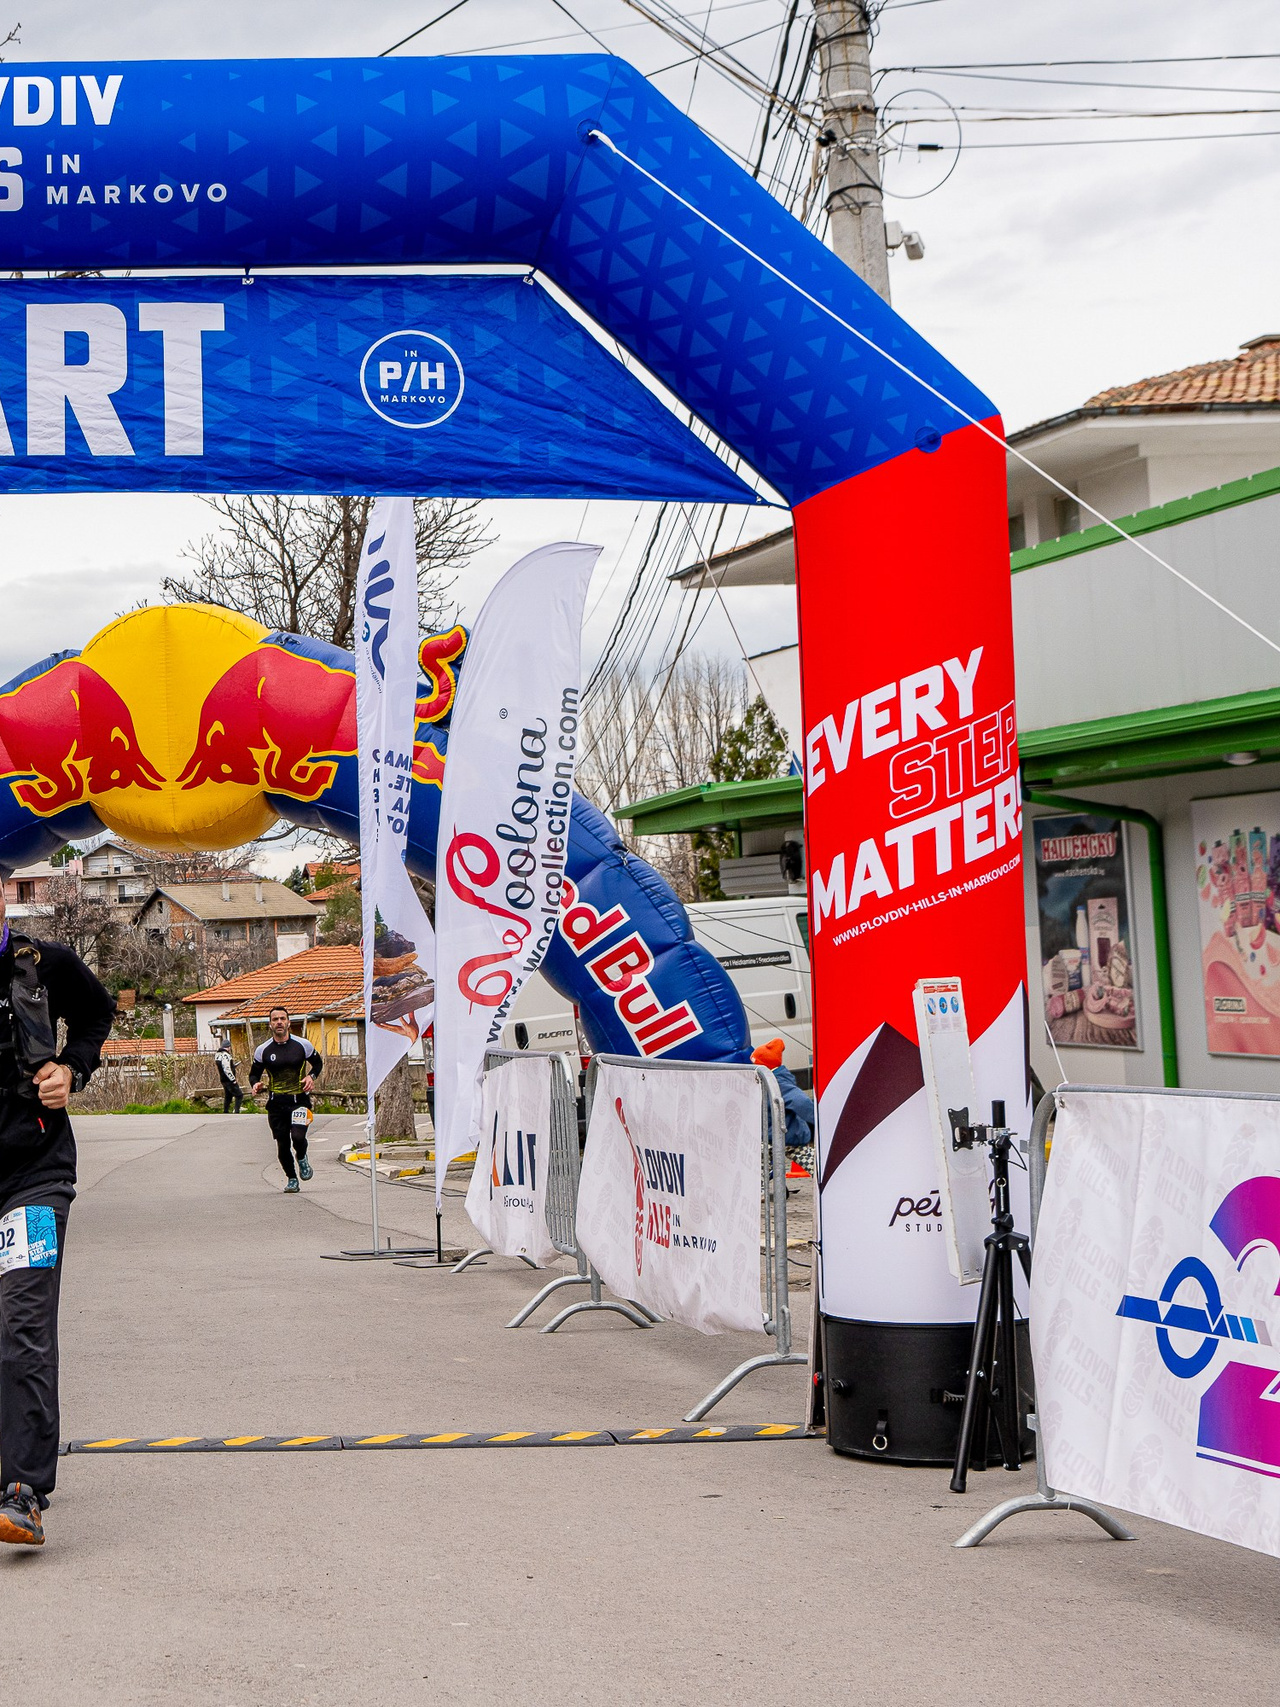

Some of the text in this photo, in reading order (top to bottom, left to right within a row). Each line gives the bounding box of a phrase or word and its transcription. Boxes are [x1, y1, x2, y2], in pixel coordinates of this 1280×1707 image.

[46, 153, 80, 174] IN
[46, 183, 229, 205] MARKOVO
[405, 350, 418, 358] IN
[379, 361, 446, 392] P/H
[380, 394, 446, 404] MARKOVO
[806, 645, 984, 798] EVERY
[889, 699, 1018, 819] STEP
[812, 765, 1023, 937] MATTER
[1041, 832, 1117, 863] НАШЕНСКО
[590, 936, 698, 1057] Bull
[537, 1029, 574, 1040] DUCATO
[672, 1213, 681, 1228] IN
[905, 1223, 943, 1233] STUD
